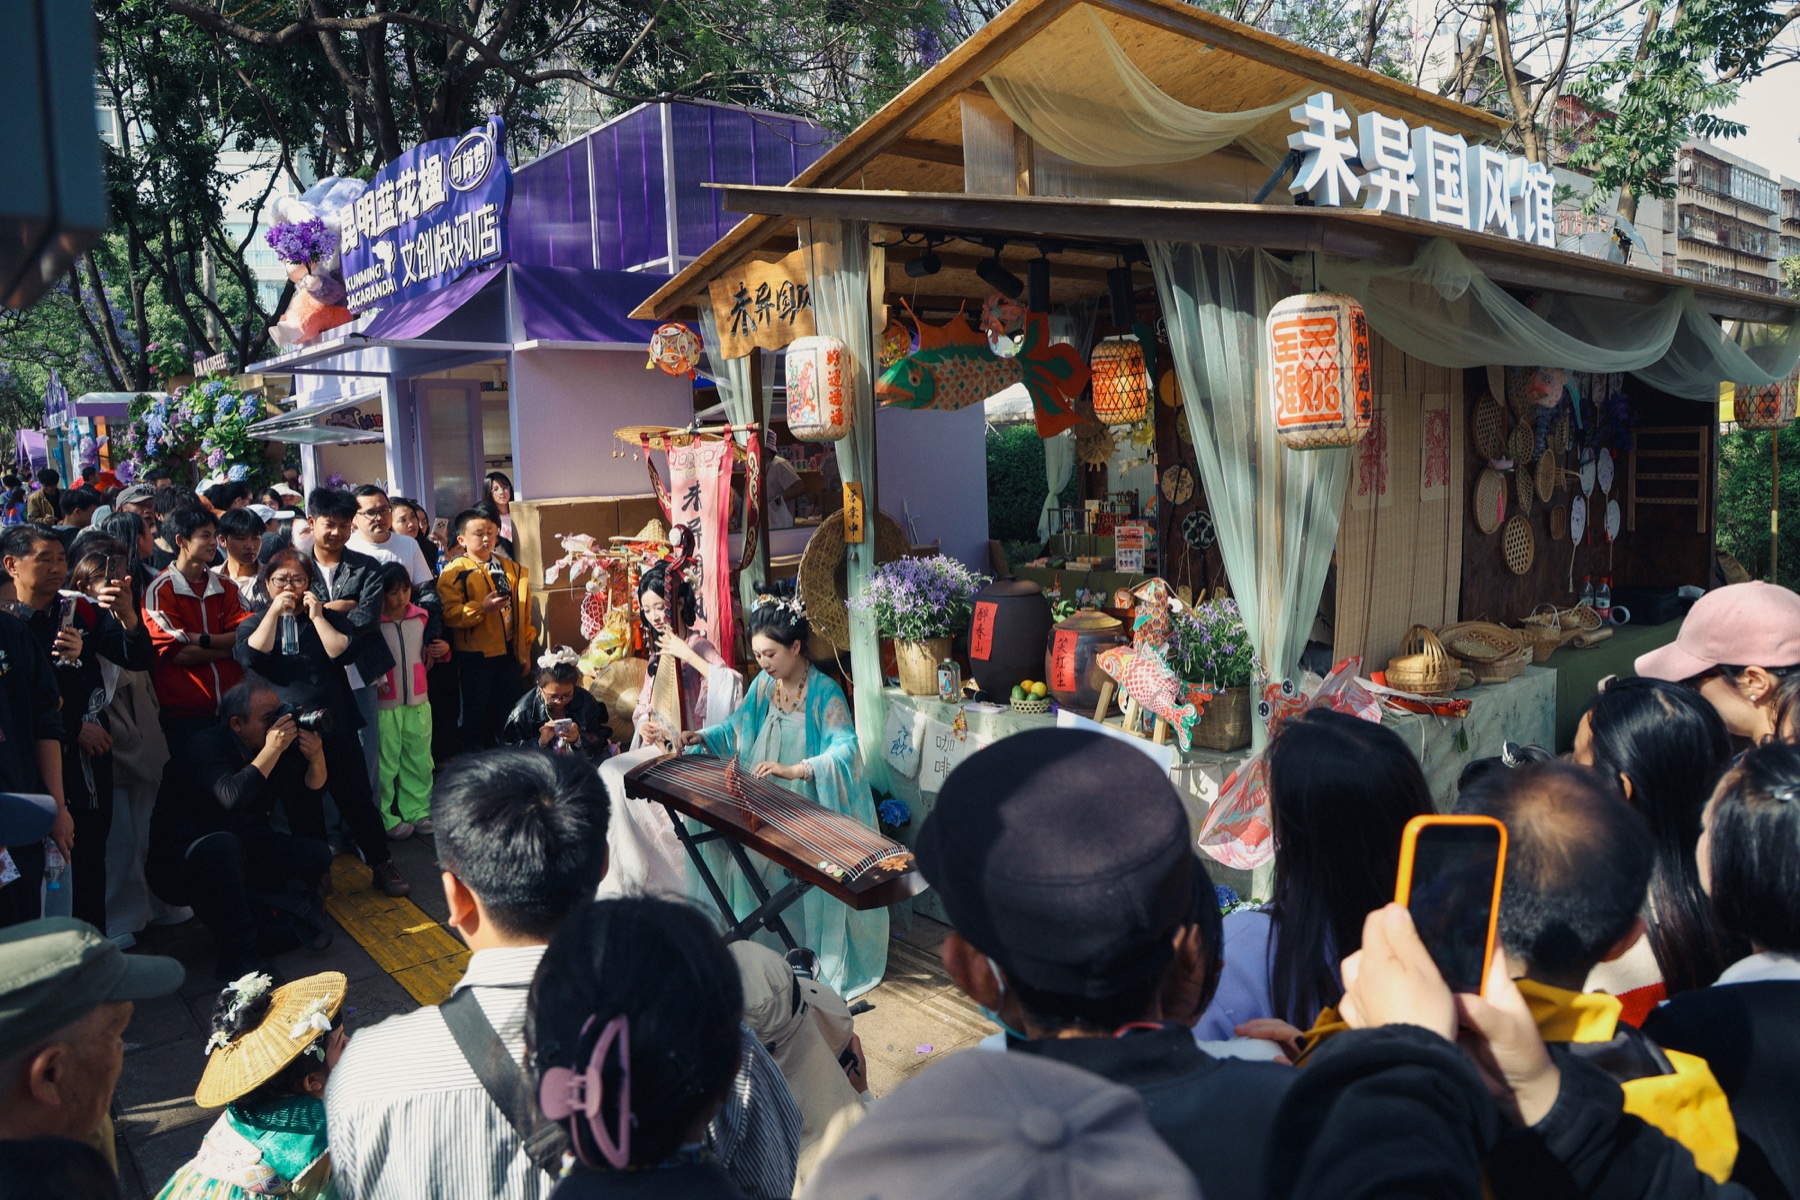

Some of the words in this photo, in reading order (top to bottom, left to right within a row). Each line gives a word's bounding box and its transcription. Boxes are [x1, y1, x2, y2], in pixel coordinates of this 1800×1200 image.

[340, 154, 447, 254] 昆明蓝花楹
[400, 203, 498, 288] 文创快闪店
[345, 263, 382, 292] KUNMING
[346, 277, 395, 310] JACARANDA
[934, 734, 955, 778] 咖啡
